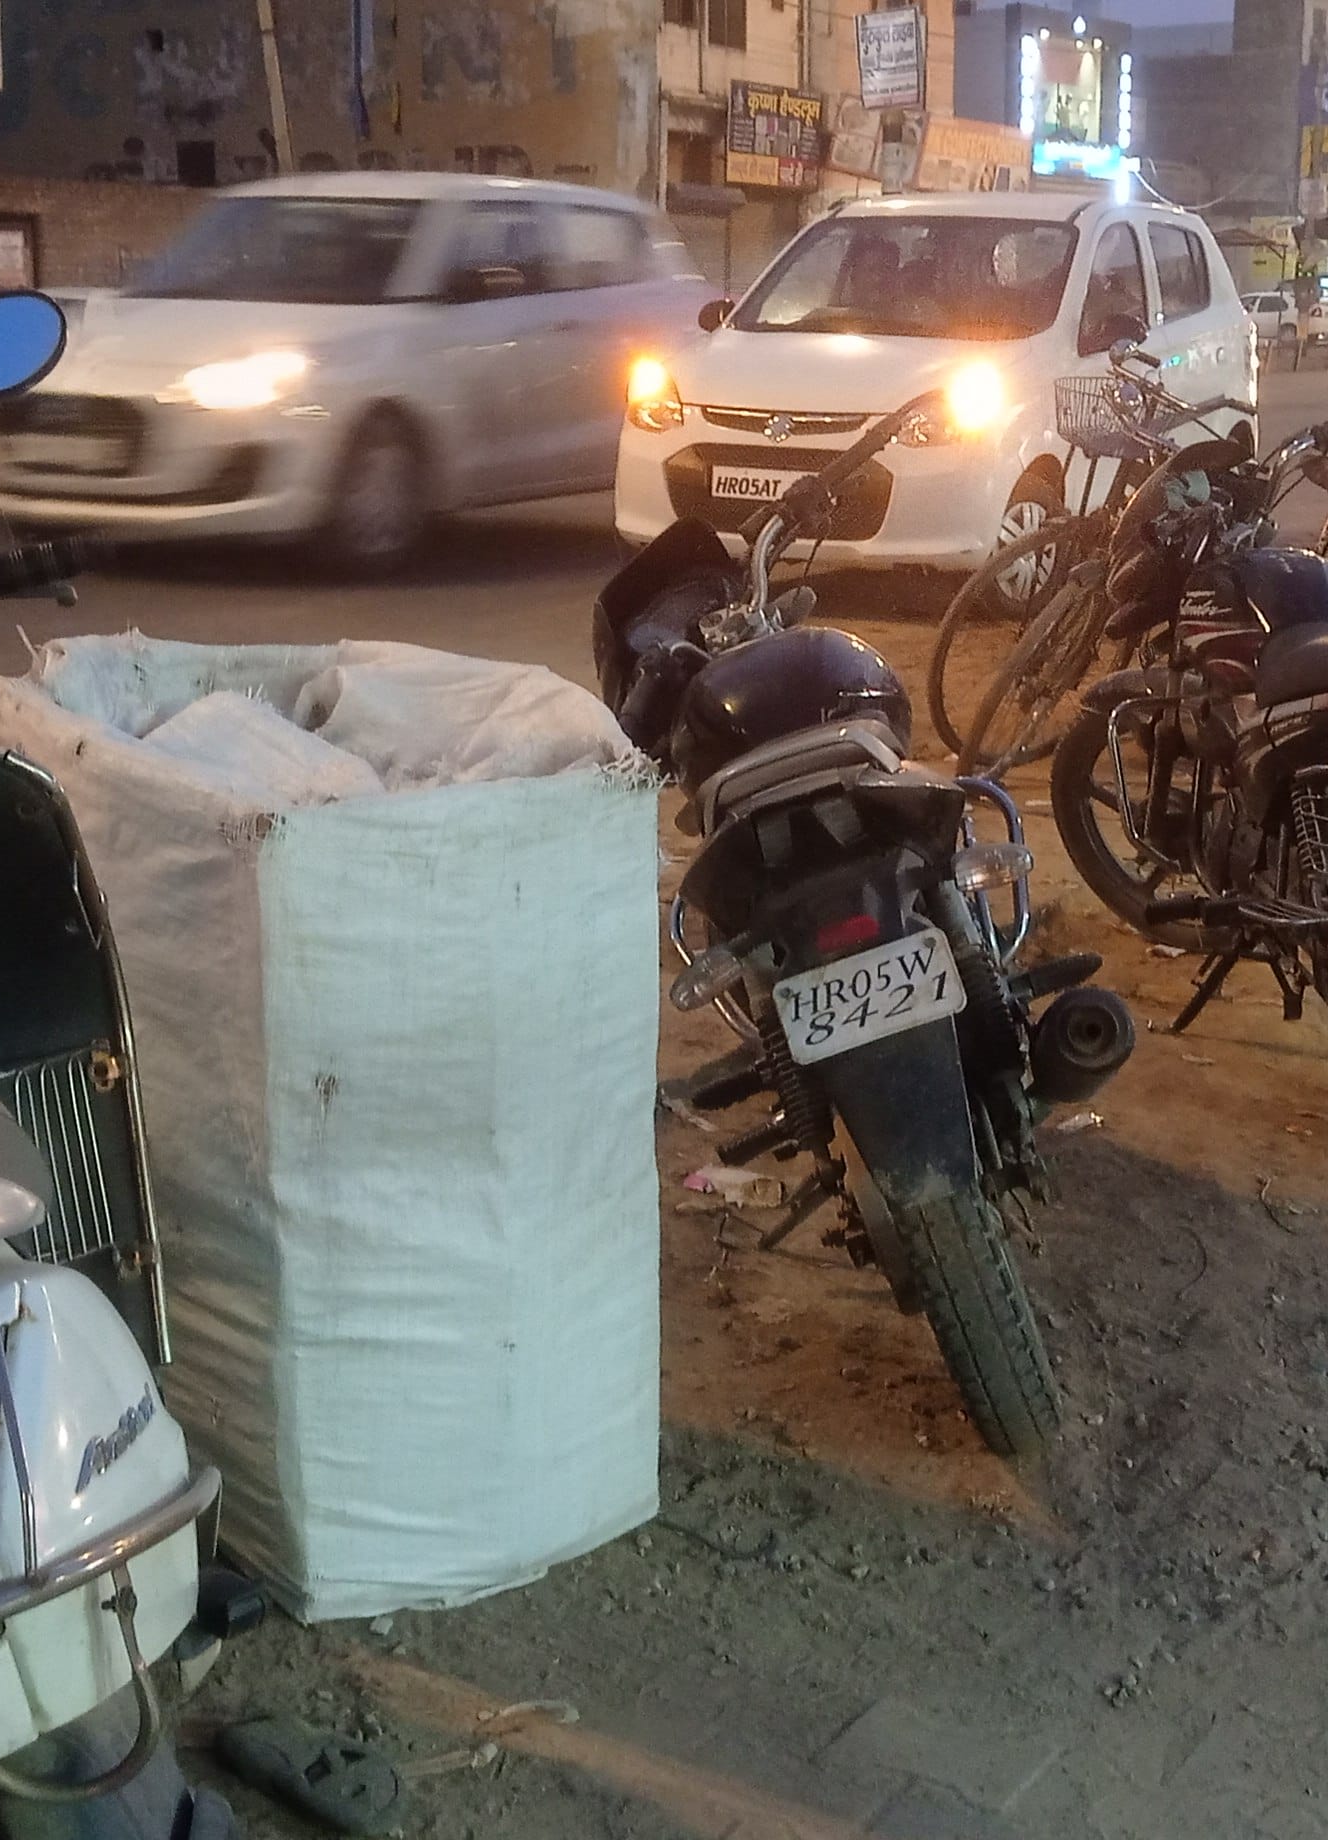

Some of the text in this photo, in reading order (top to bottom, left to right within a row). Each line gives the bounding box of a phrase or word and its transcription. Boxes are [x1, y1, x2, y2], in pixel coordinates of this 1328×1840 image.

[714, 475, 782, 498] HR05AT
[790, 947, 935, 1022] HR05W
[805, 970, 947, 1046] 8421
